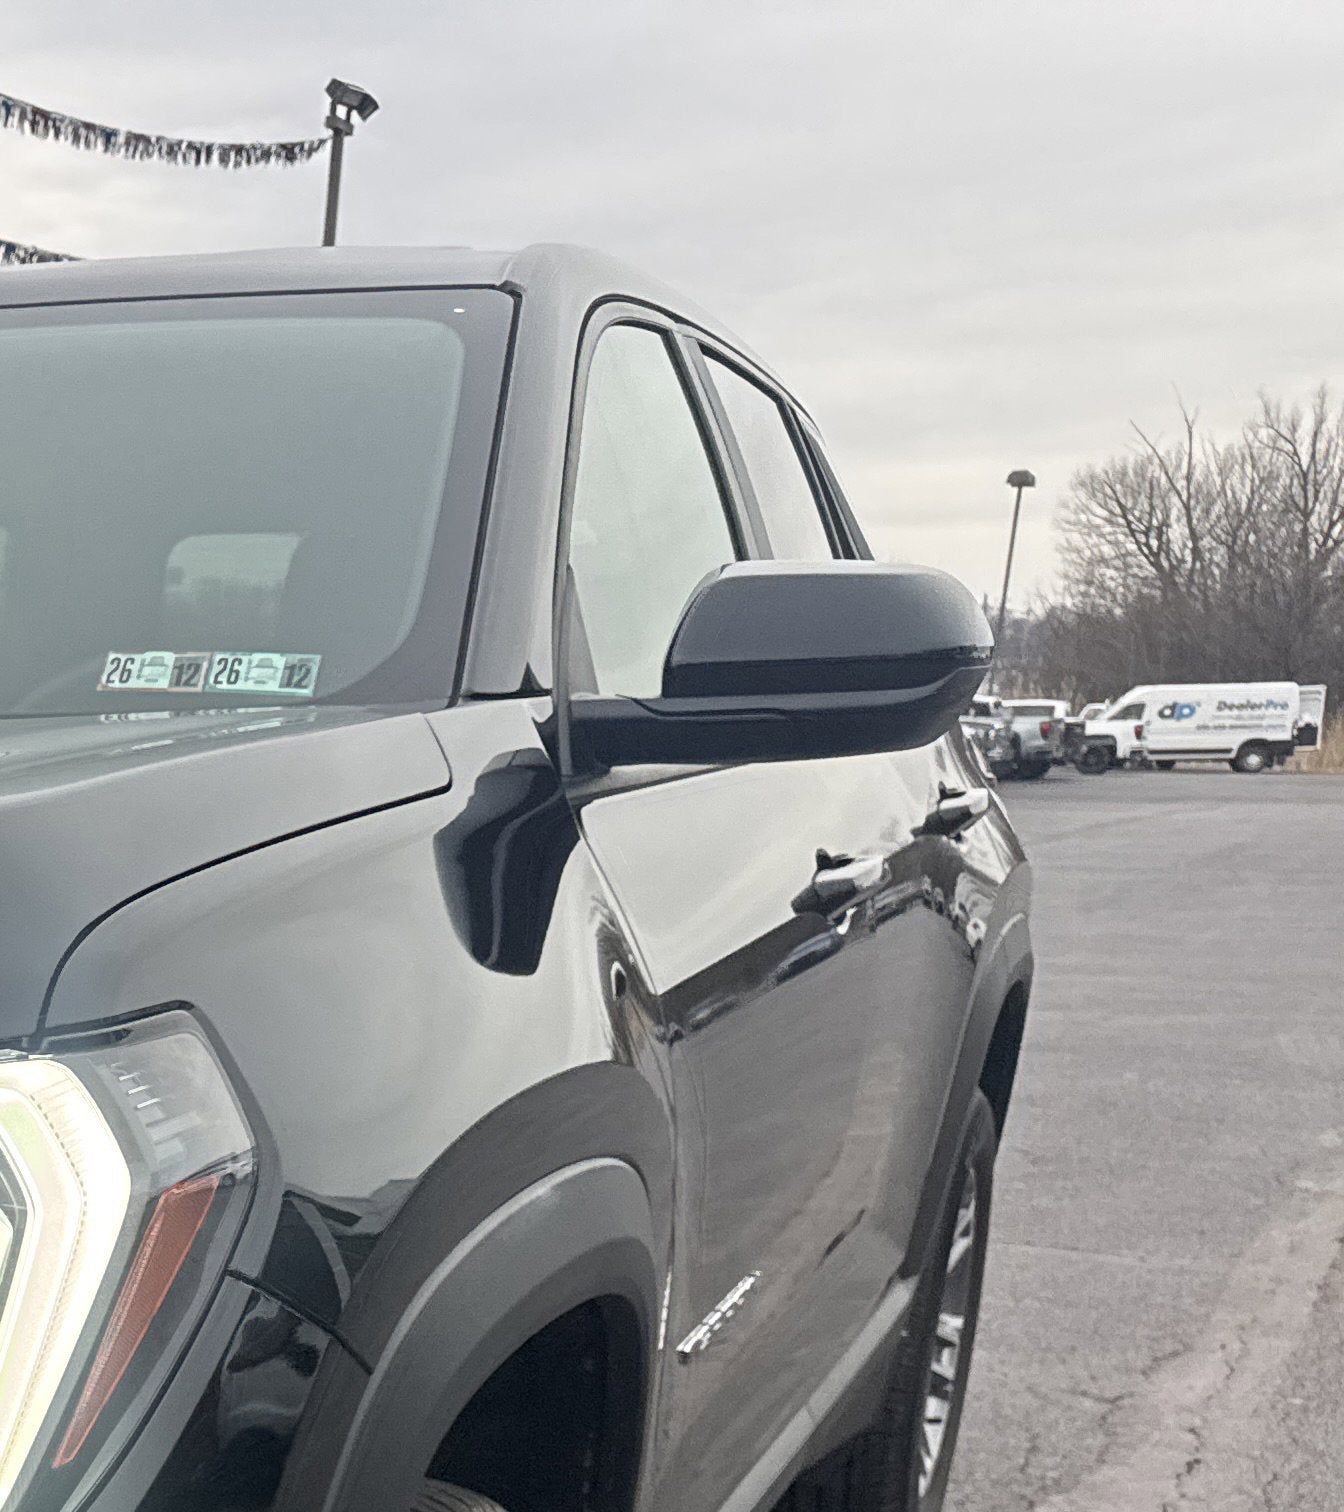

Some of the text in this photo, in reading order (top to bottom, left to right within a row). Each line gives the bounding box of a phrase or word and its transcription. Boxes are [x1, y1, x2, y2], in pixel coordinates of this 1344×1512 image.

[106, 657, 202, 687] 26 12
[213, 657, 311, 689] 26 12
